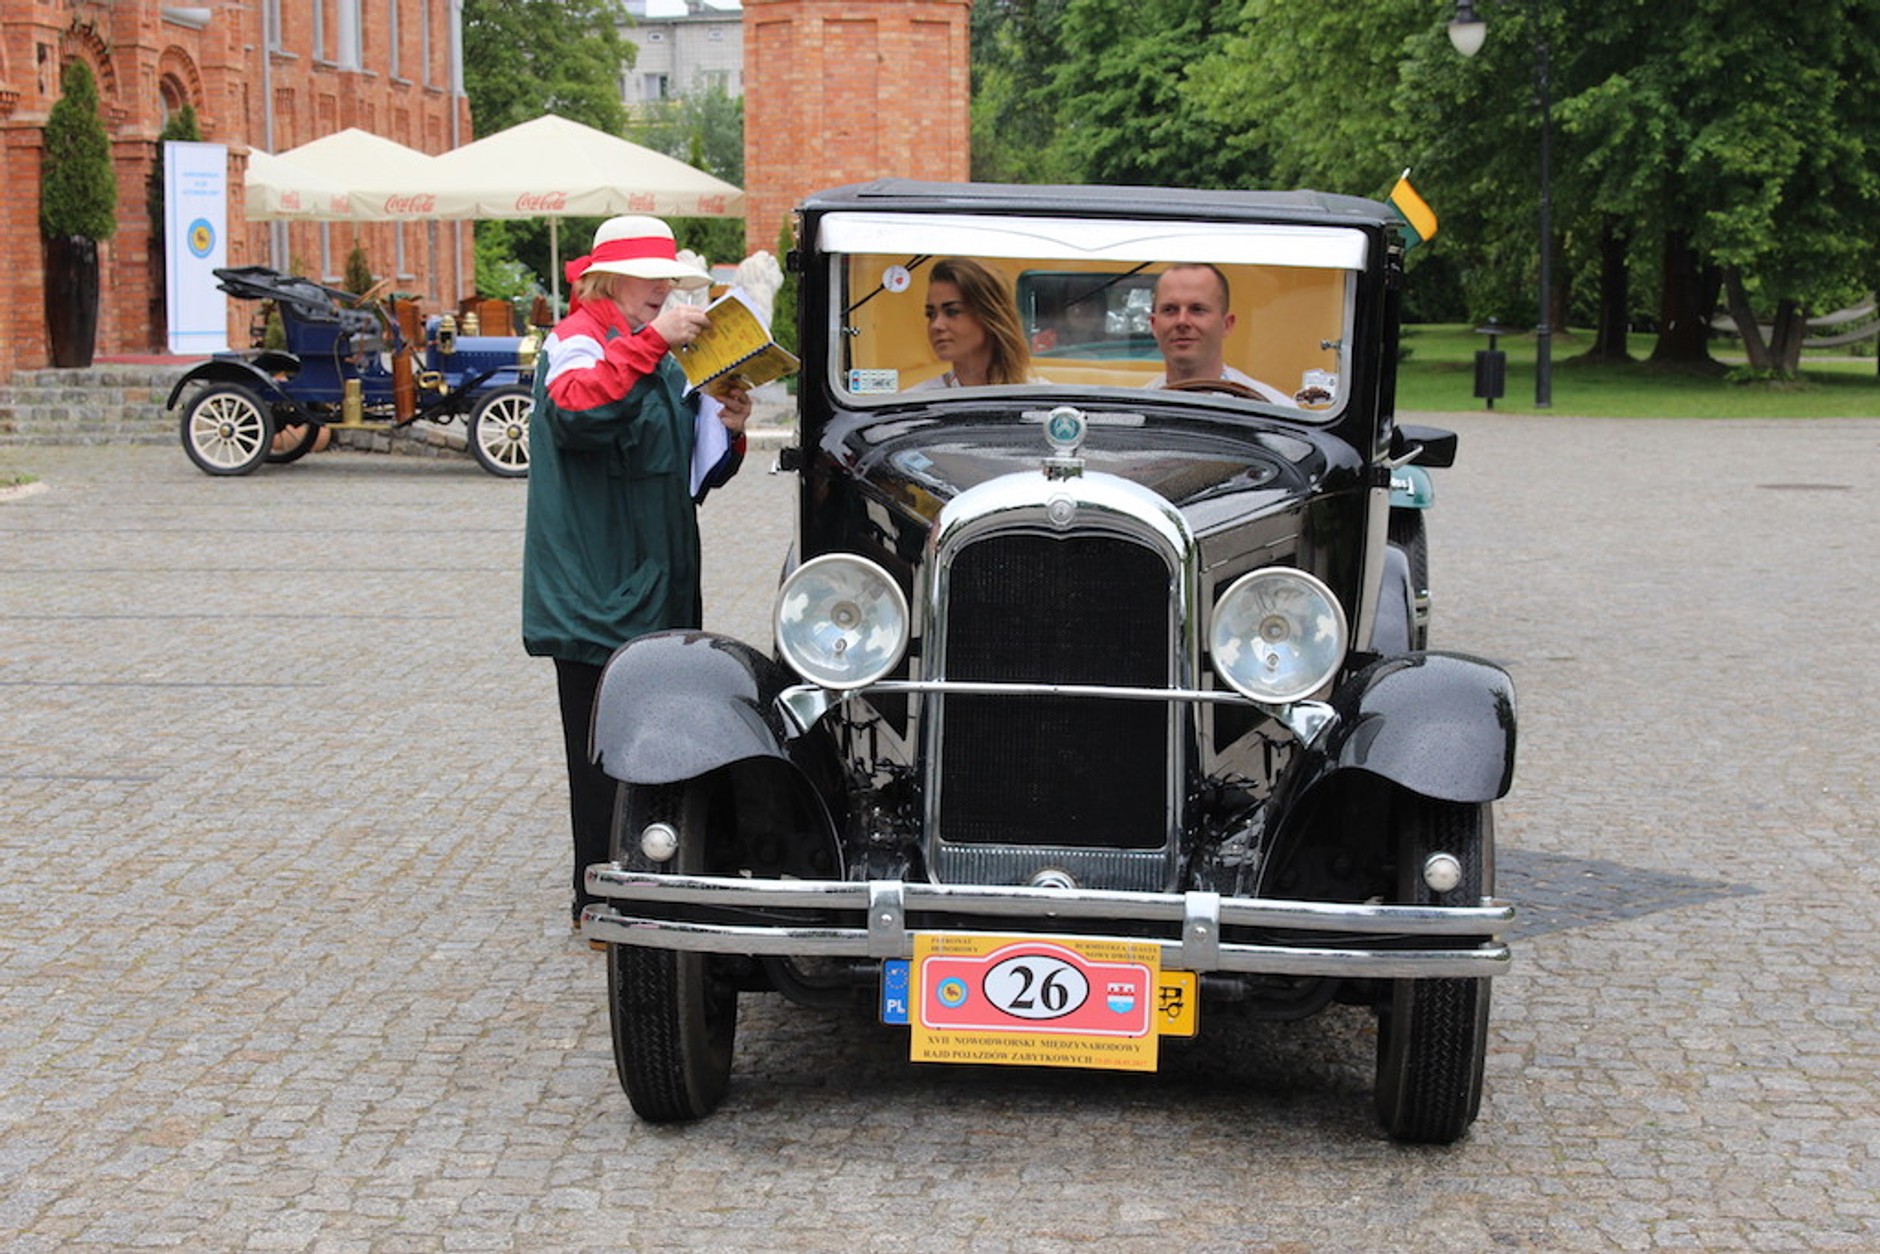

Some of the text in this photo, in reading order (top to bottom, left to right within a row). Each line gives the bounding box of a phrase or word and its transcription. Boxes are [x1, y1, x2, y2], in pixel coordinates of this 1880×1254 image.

[1008, 965, 1068, 1011] 26
[886, 999, 906, 1014] PL
[927, 1036, 1141, 1053] XVII NOWODWORSKI MIĘDZYNARODOWY
[923, 1050, 950, 1059] RAJD
[952, 1050, 1008, 1060] POJAZDÓW
[1011, 1052, 1093, 1064] ZABYTKOWYCH
